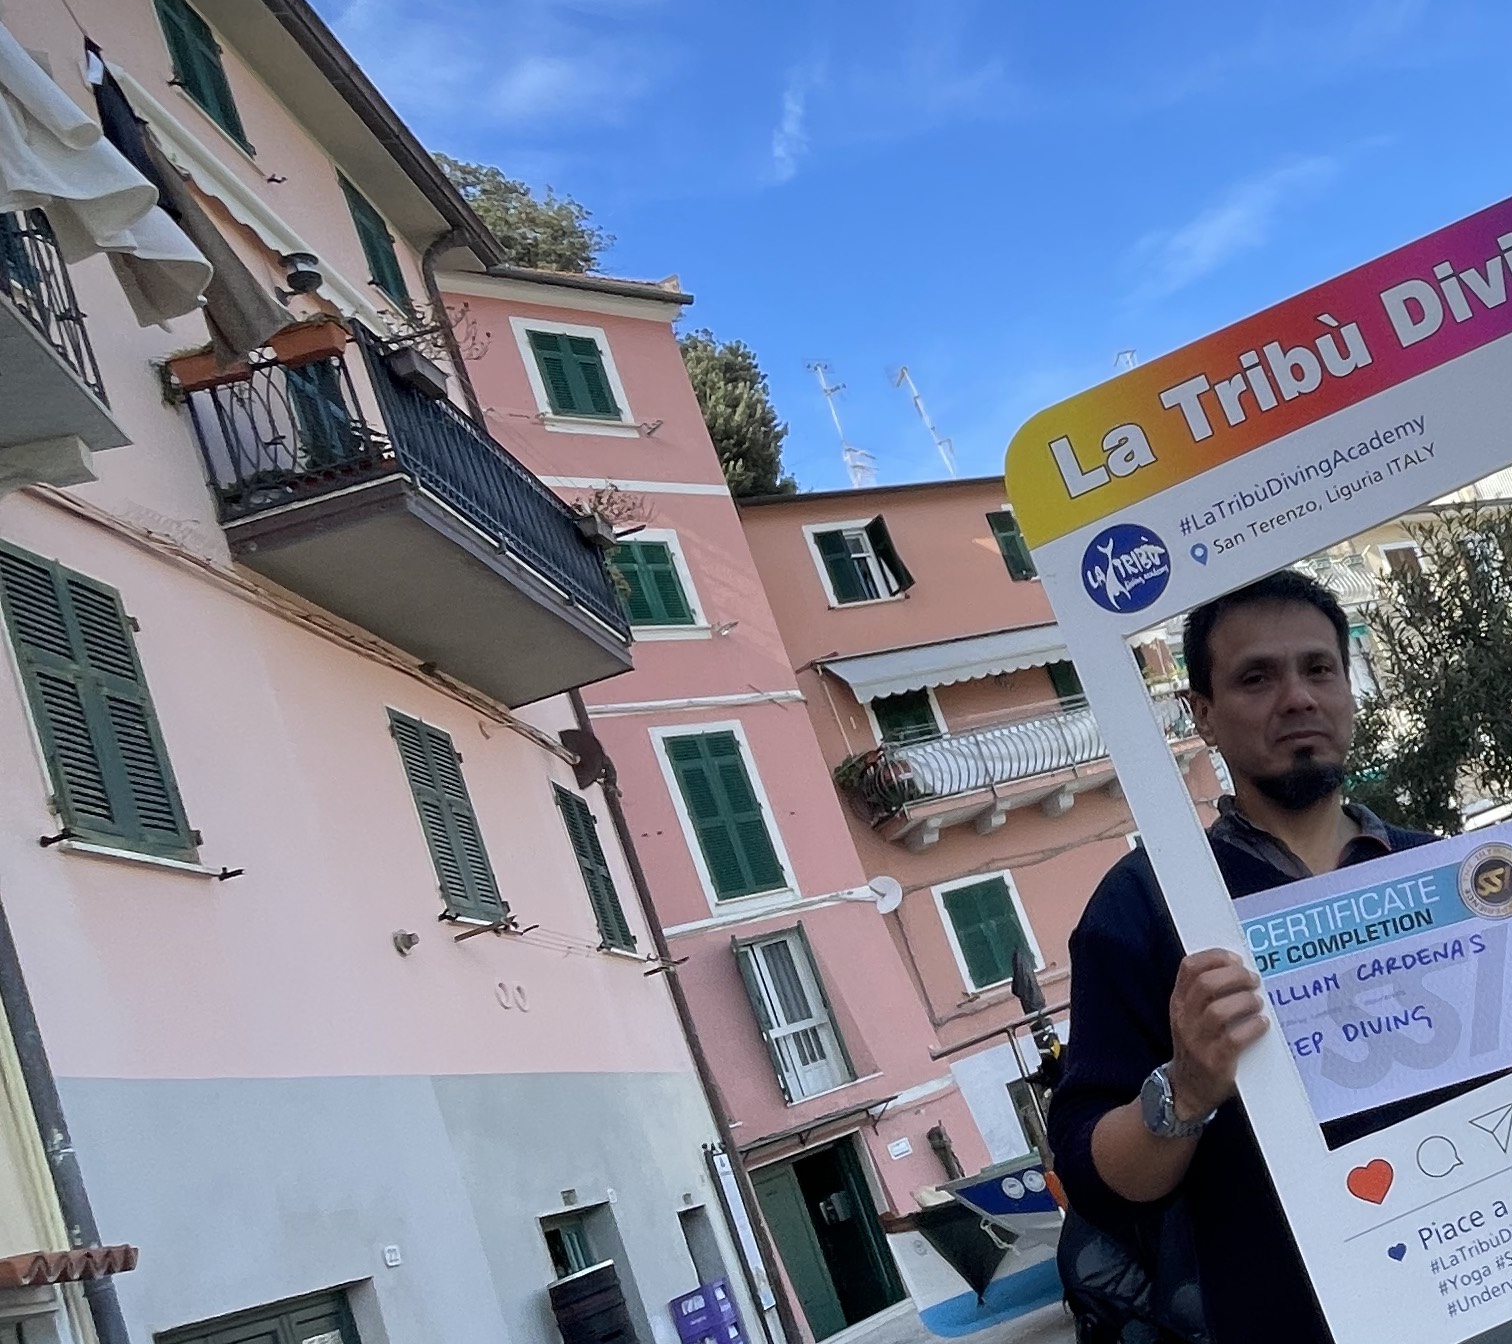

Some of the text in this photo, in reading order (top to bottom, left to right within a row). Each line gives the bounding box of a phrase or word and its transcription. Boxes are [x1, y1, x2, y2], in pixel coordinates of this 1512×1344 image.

[1048, 422, 1157, 500] La
[1160, 314, 1373, 444] Tribù
[1179, 415, 1426, 536] #LaTribùDivingAcademy
[1213, 443, 1437, 554] San Terenzo, Liguria ITALY
[1246, 875, 1441, 951] CERTIFICATE
[1255, 908, 1434, 972] OF COMPLETION
[1267, 973, 1341, 1006] ILLIAM
[1357, 934, 1487, 981] CARDENAS
[1289, 1031, 1324, 1058] EP
[1342, 1005, 1433, 1043] DIVING
[1417, 1208, 1485, 1251] Piace
[1493, 1199, 1509, 1218] a
[1439, 1264, 1492, 1297] #Yoga
